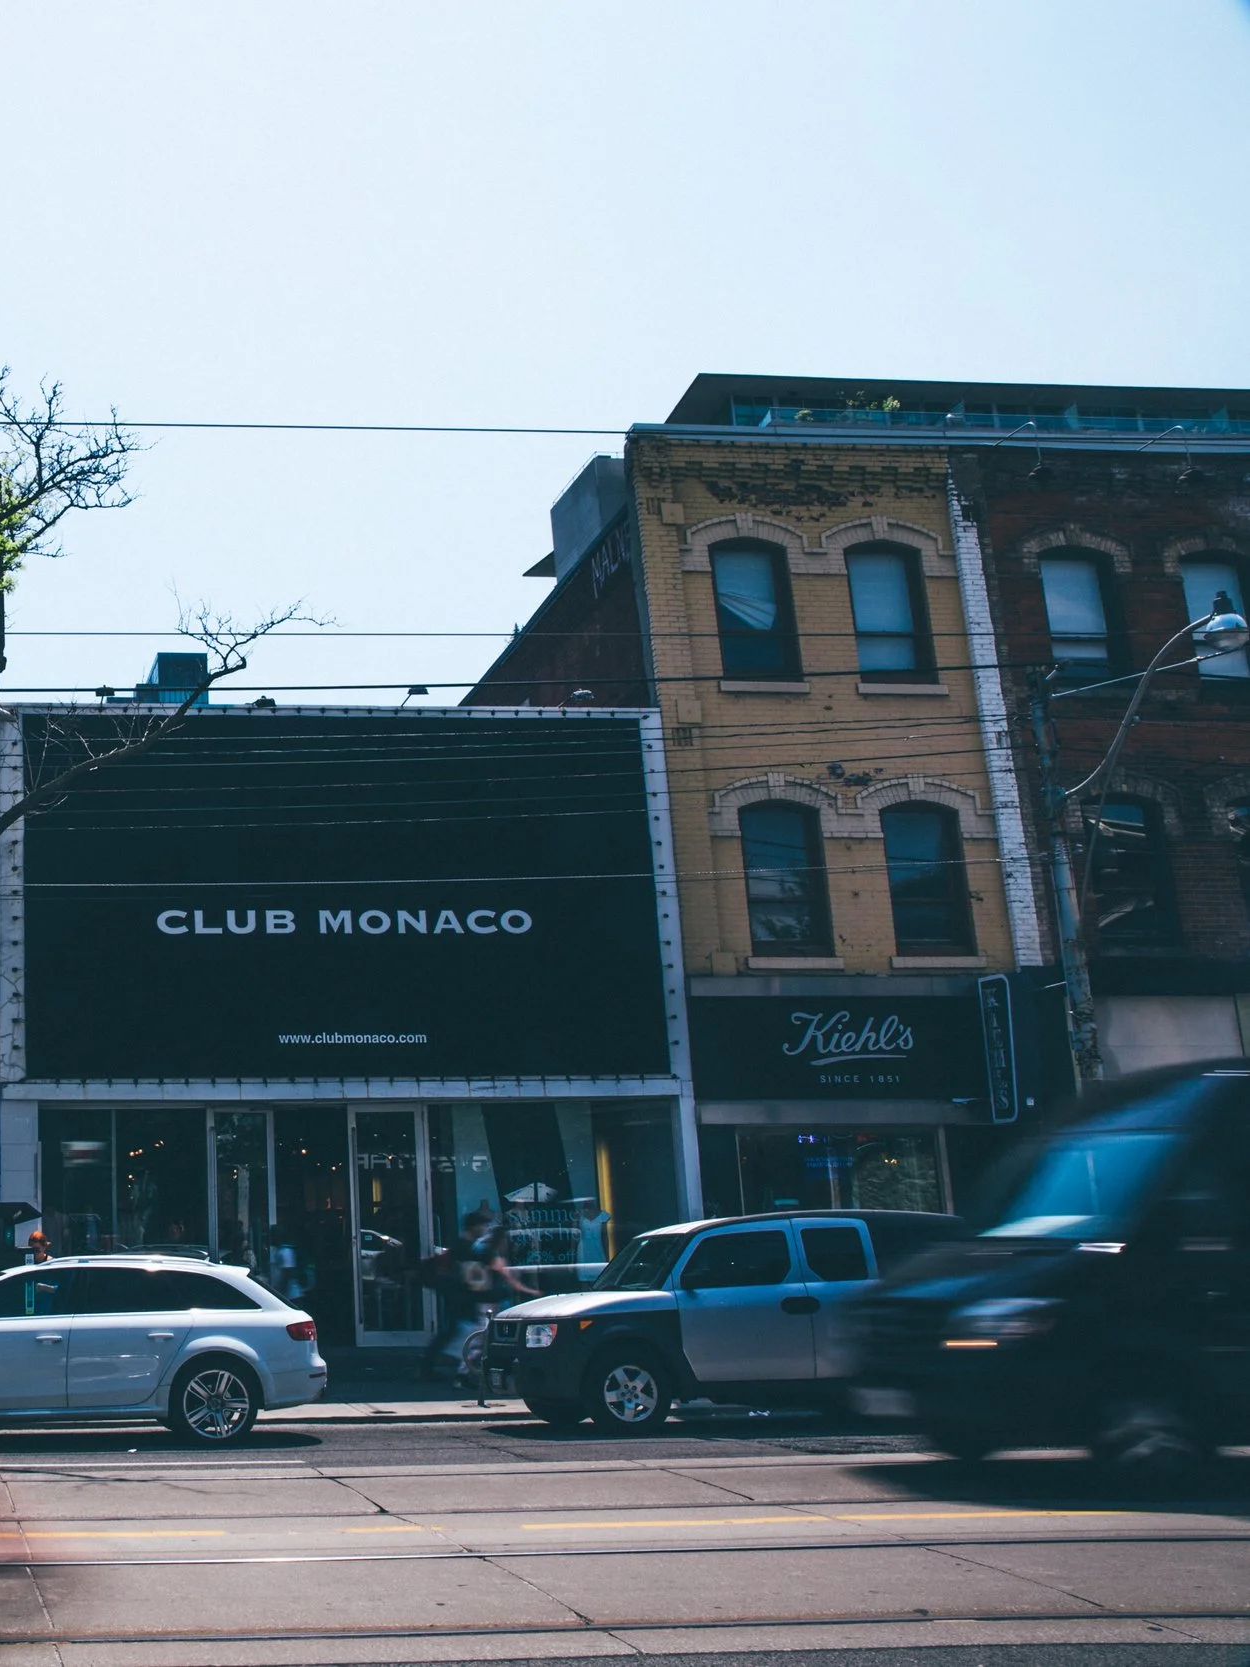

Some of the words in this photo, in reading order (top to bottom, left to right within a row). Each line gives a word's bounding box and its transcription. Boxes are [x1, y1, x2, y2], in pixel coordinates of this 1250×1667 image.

[156, 909, 296, 935] CLUB
[319, 909, 533, 935] MONACO
[278, 1031, 427, 1044] www.clubmonaco.com
[782, 1011, 914, 1055] Kiehl's
[819, 1074, 860, 1083] SINCE
[870, 1075, 901, 1083] 1851
[509, 1208, 585, 1222] summe
